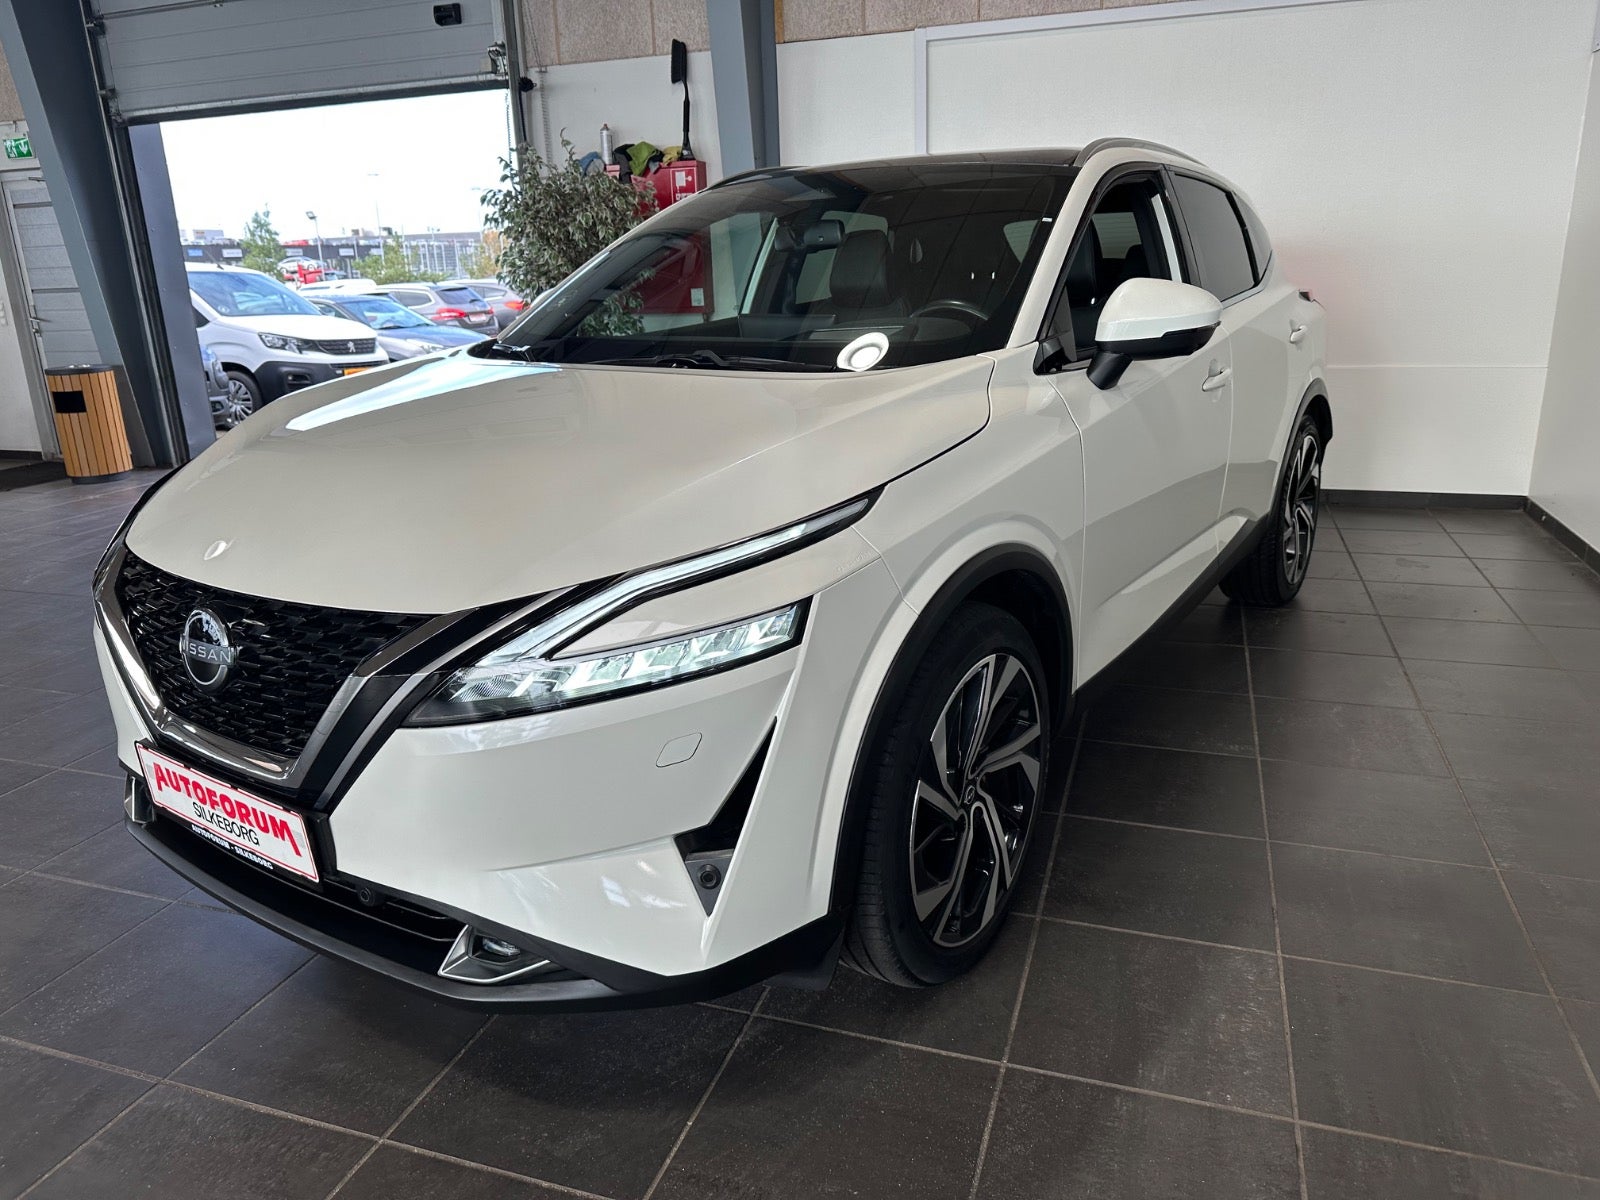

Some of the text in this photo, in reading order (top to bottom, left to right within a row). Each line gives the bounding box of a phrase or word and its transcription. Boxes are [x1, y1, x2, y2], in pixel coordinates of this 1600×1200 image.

[179, 636, 232, 663] NISSAN
[153, 762, 302, 857] AUTOFORUM
[192, 802, 260, 846] SILKEBORG
